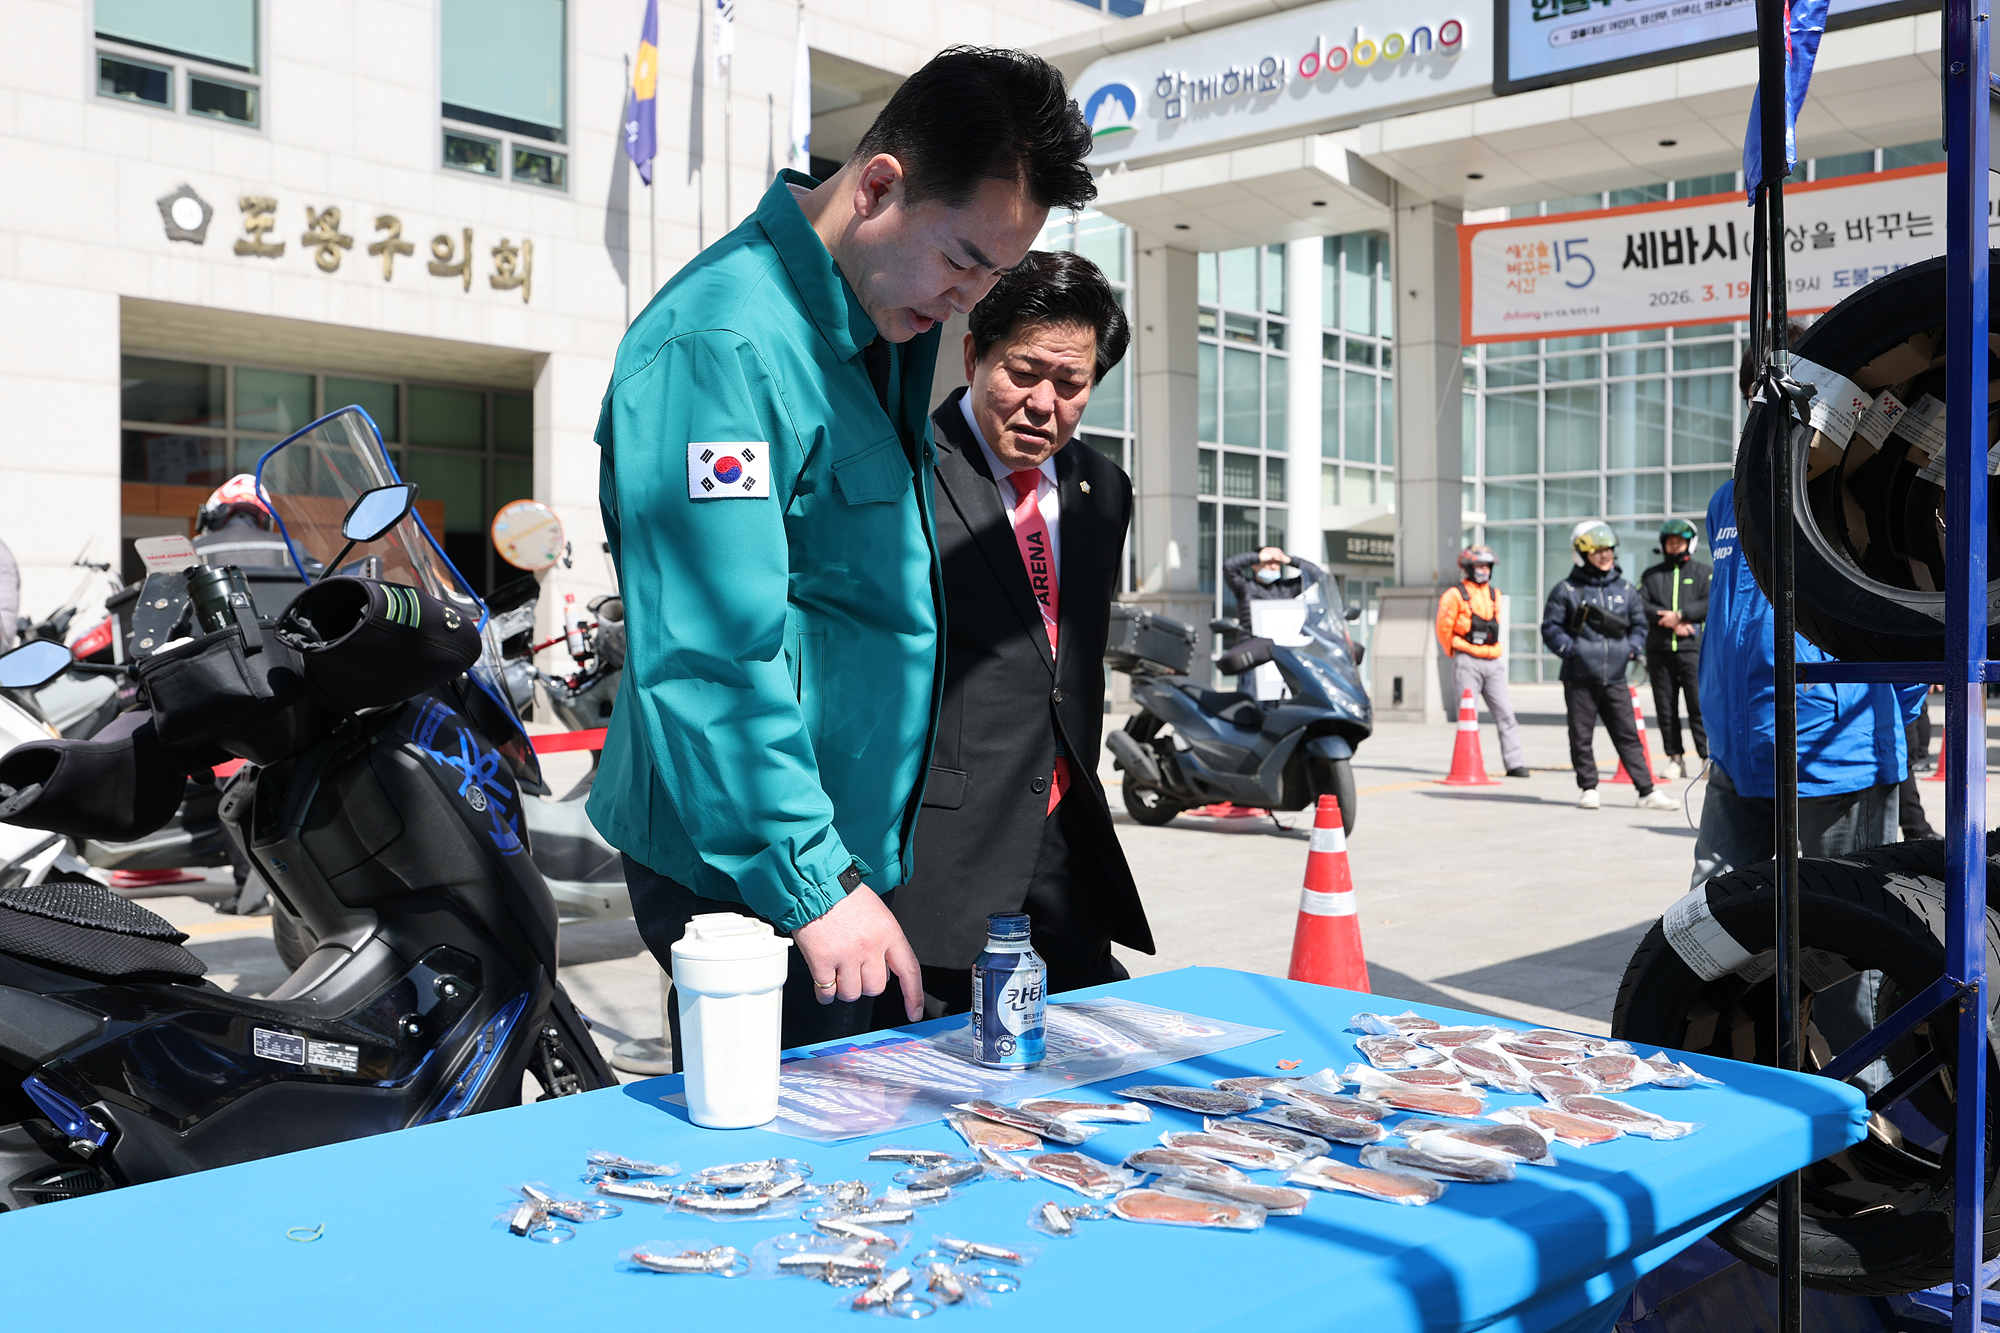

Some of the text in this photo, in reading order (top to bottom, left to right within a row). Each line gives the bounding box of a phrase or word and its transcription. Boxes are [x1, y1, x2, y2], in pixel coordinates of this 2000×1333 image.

[1298, 20, 1465, 79] dobong
[233, 196, 533, 304] 도봉구의회
[1506, 241, 1549, 259] 세상을
[1622, 221, 1738, 270] 세바시
[1846, 212, 1934, 243] 바꾸는
[1506, 261, 1551, 275] 바꾸는
[1506, 278, 1537, 294] 시간
[1649, 290, 1695, 307] 2026.
[1026, 530, 1051, 607] ARENA
